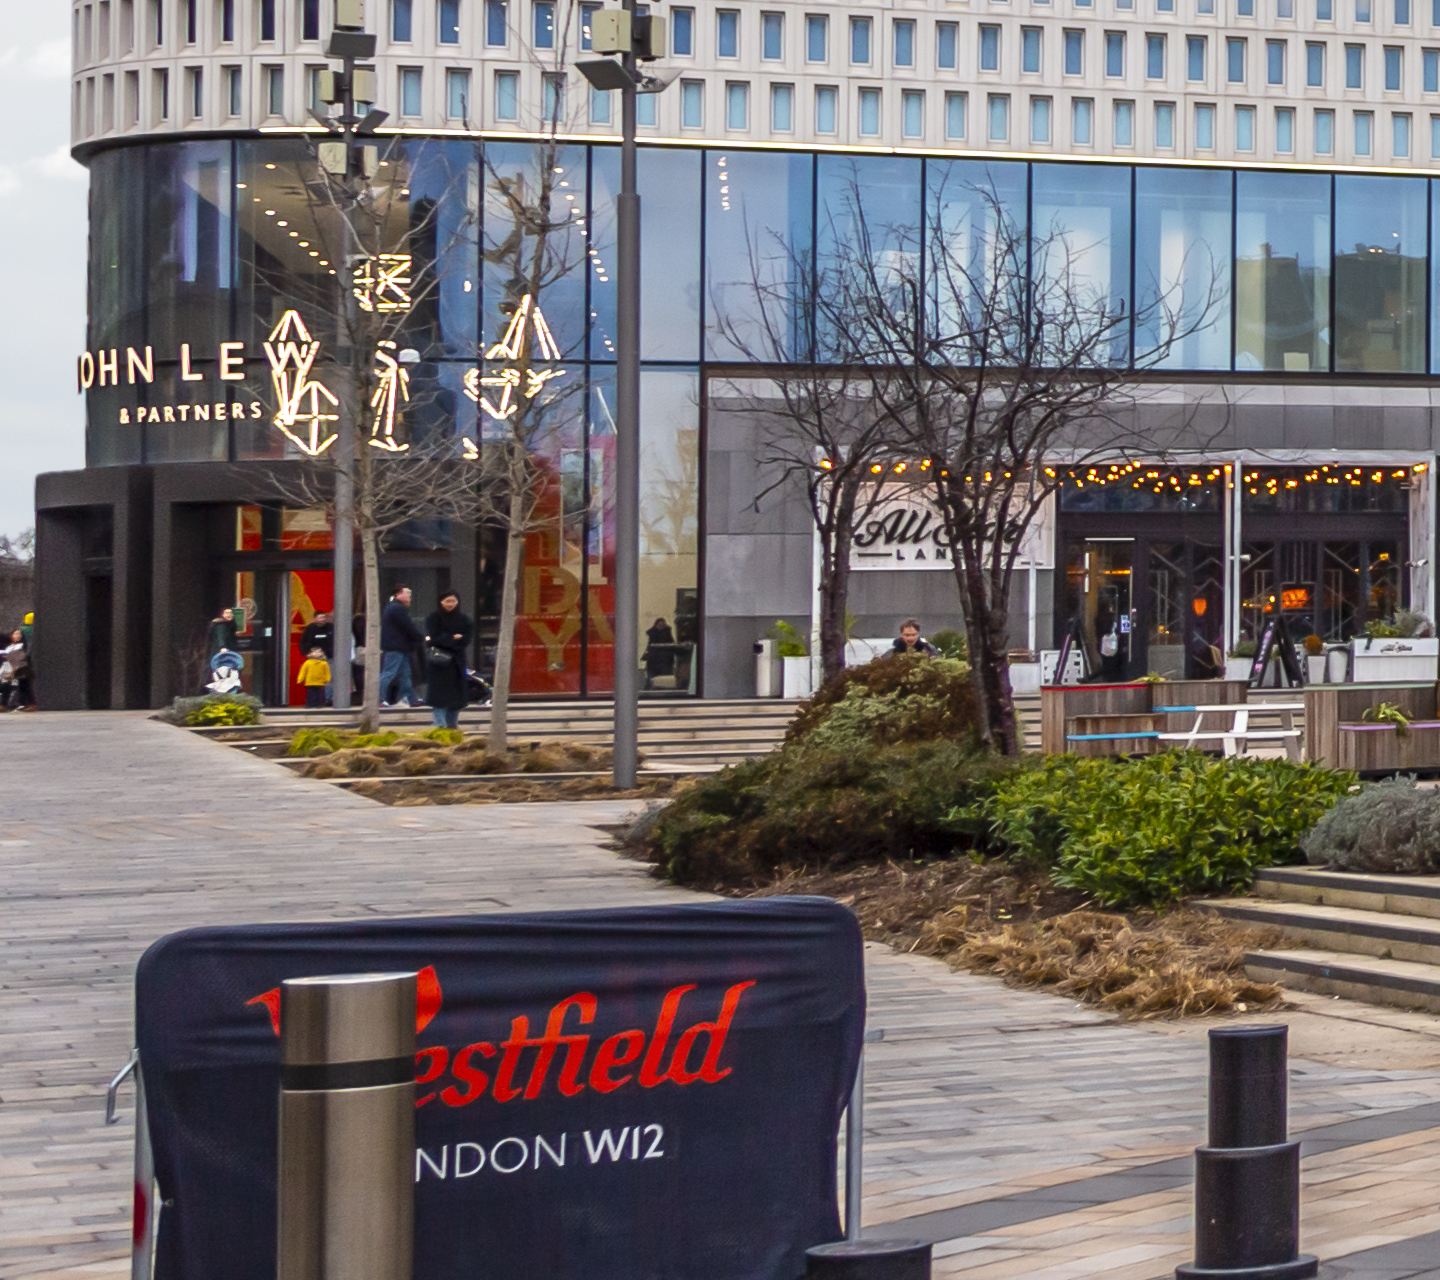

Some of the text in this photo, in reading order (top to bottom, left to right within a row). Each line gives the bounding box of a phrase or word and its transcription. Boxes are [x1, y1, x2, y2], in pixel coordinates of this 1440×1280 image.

[119, 401, 263, 424] & PARTNERS
[853, 508, 932, 548] All
[245, 965, 757, 1107] estfield
[415, 1123, 665, 1182] NDON W12
